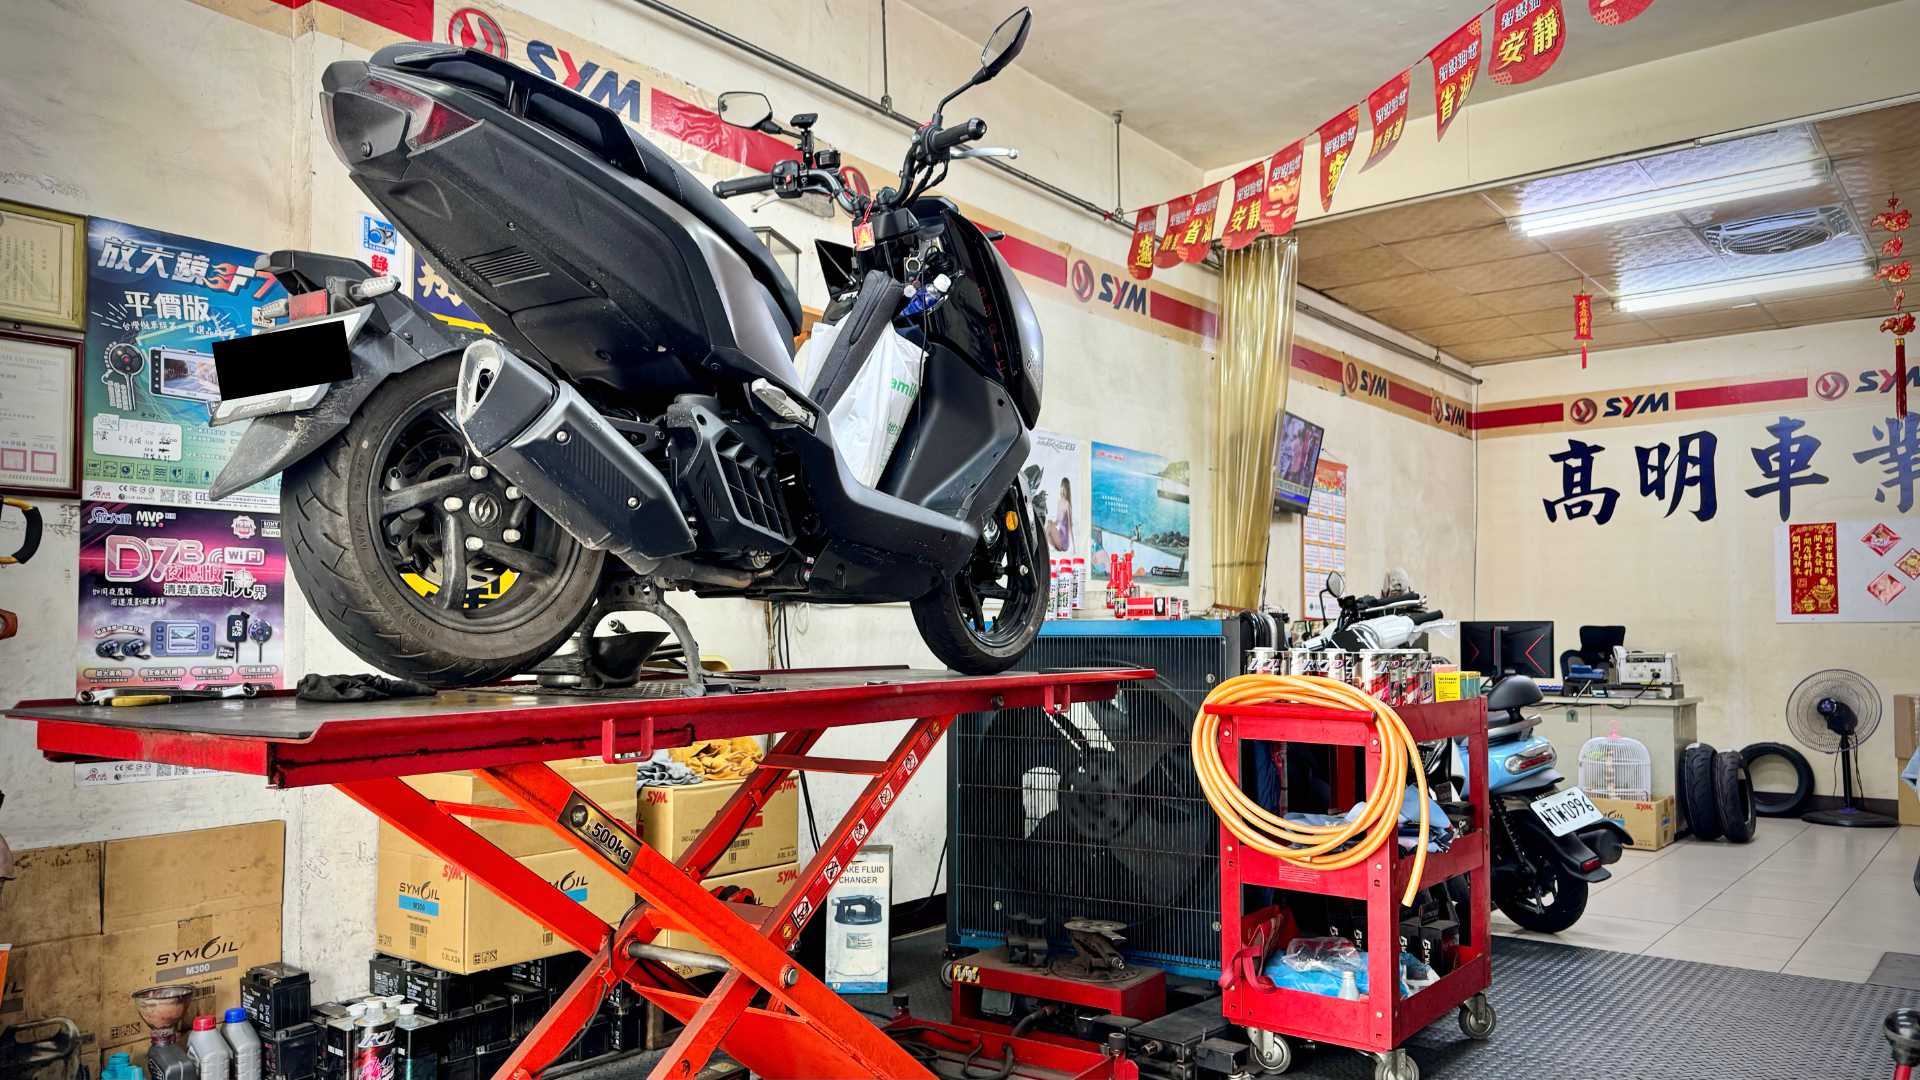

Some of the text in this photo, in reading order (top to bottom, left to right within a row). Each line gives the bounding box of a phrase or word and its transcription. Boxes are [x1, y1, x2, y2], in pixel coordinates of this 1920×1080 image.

[1497, 7, 1557, 70] 安靜
[526, 40, 640, 122] SYM
[1440, 66, 1475, 124] 省油
[1230, 200, 1261, 233] 安靜
[97, 236, 211, 285] 放大鏡
[123, 290, 210, 322] 平價版
[1099, 273, 1147, 315] SYM
[1360, 369, 1387, 399] SYM
[1444, 402, 1465, 427] SYM
[1603, 391, 1669, 418] SYM
[136, 511, 164, 523] MVP
[105, 535, 205, 582] D7B
[647, 791, 668, 806] SYM
[591, 822, 632, 865] 500kg
[862, 866, 884, 874] FLUID
[186, 964, 210, 976] M300
